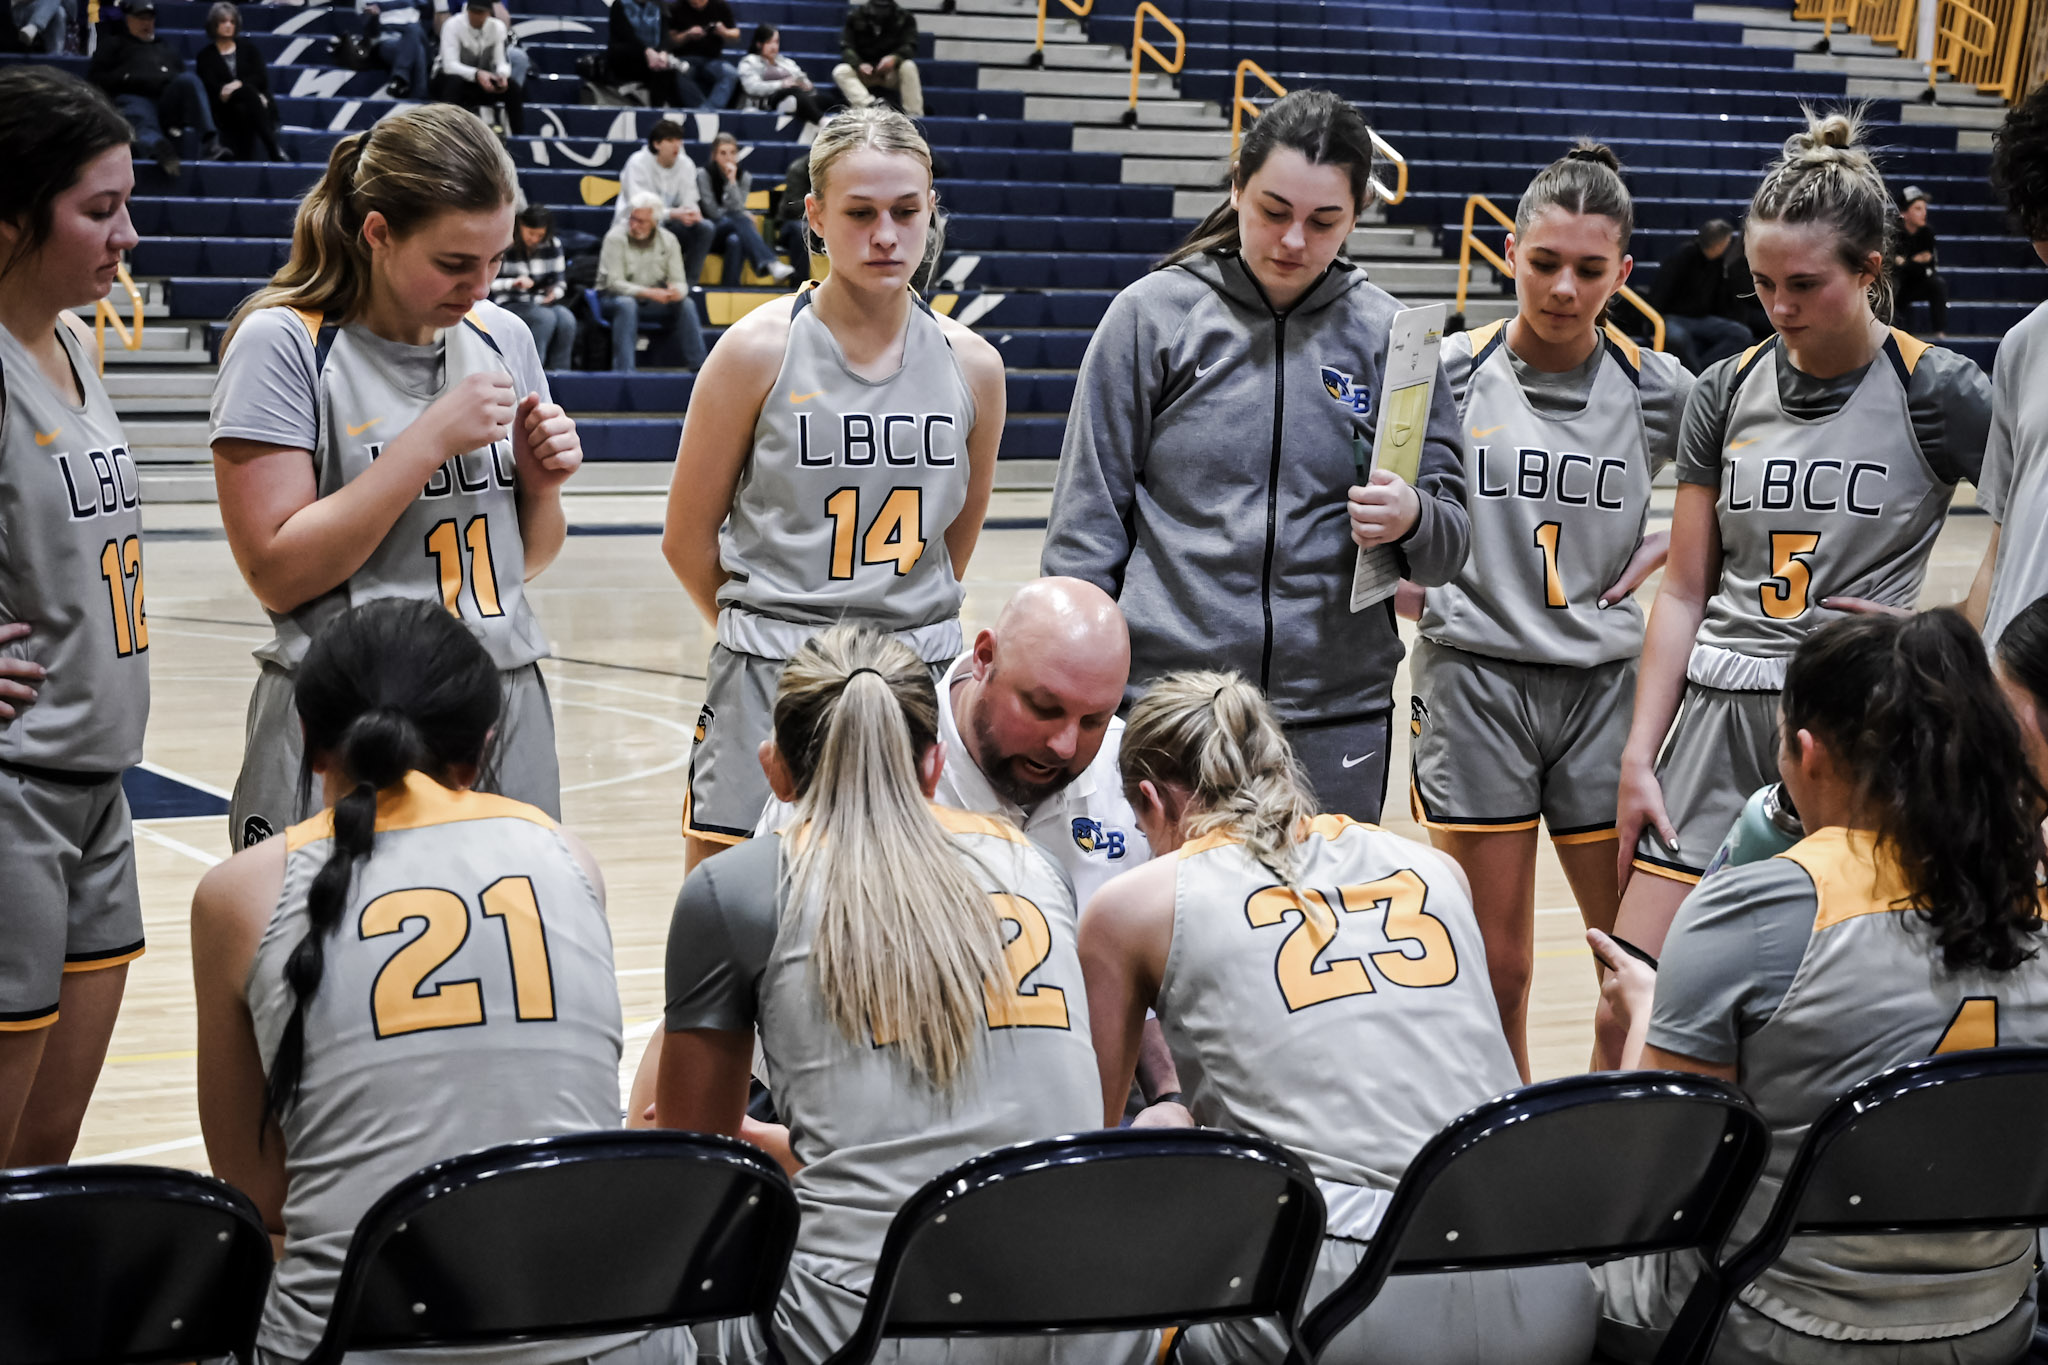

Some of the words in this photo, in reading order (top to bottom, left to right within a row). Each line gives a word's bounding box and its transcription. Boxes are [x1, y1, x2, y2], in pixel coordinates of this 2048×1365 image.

[52, 442, 141, 521] LBC
[793, 411, 957, 469] LBCC
[1473, 445, 1628, 512] LBCC
[1727, 457, 1890, 519] LBCC
[424, 513, 506, 618] 11
[824, 486, 928, 580] 14
[1534, 520, 1569, 609] 1
[1758, 530, 1822, 619] 5
[100, 534, 148, 658] 12
[358, 875, 557, 1040] 21
[1244, 868, 1459, 1014] 23
